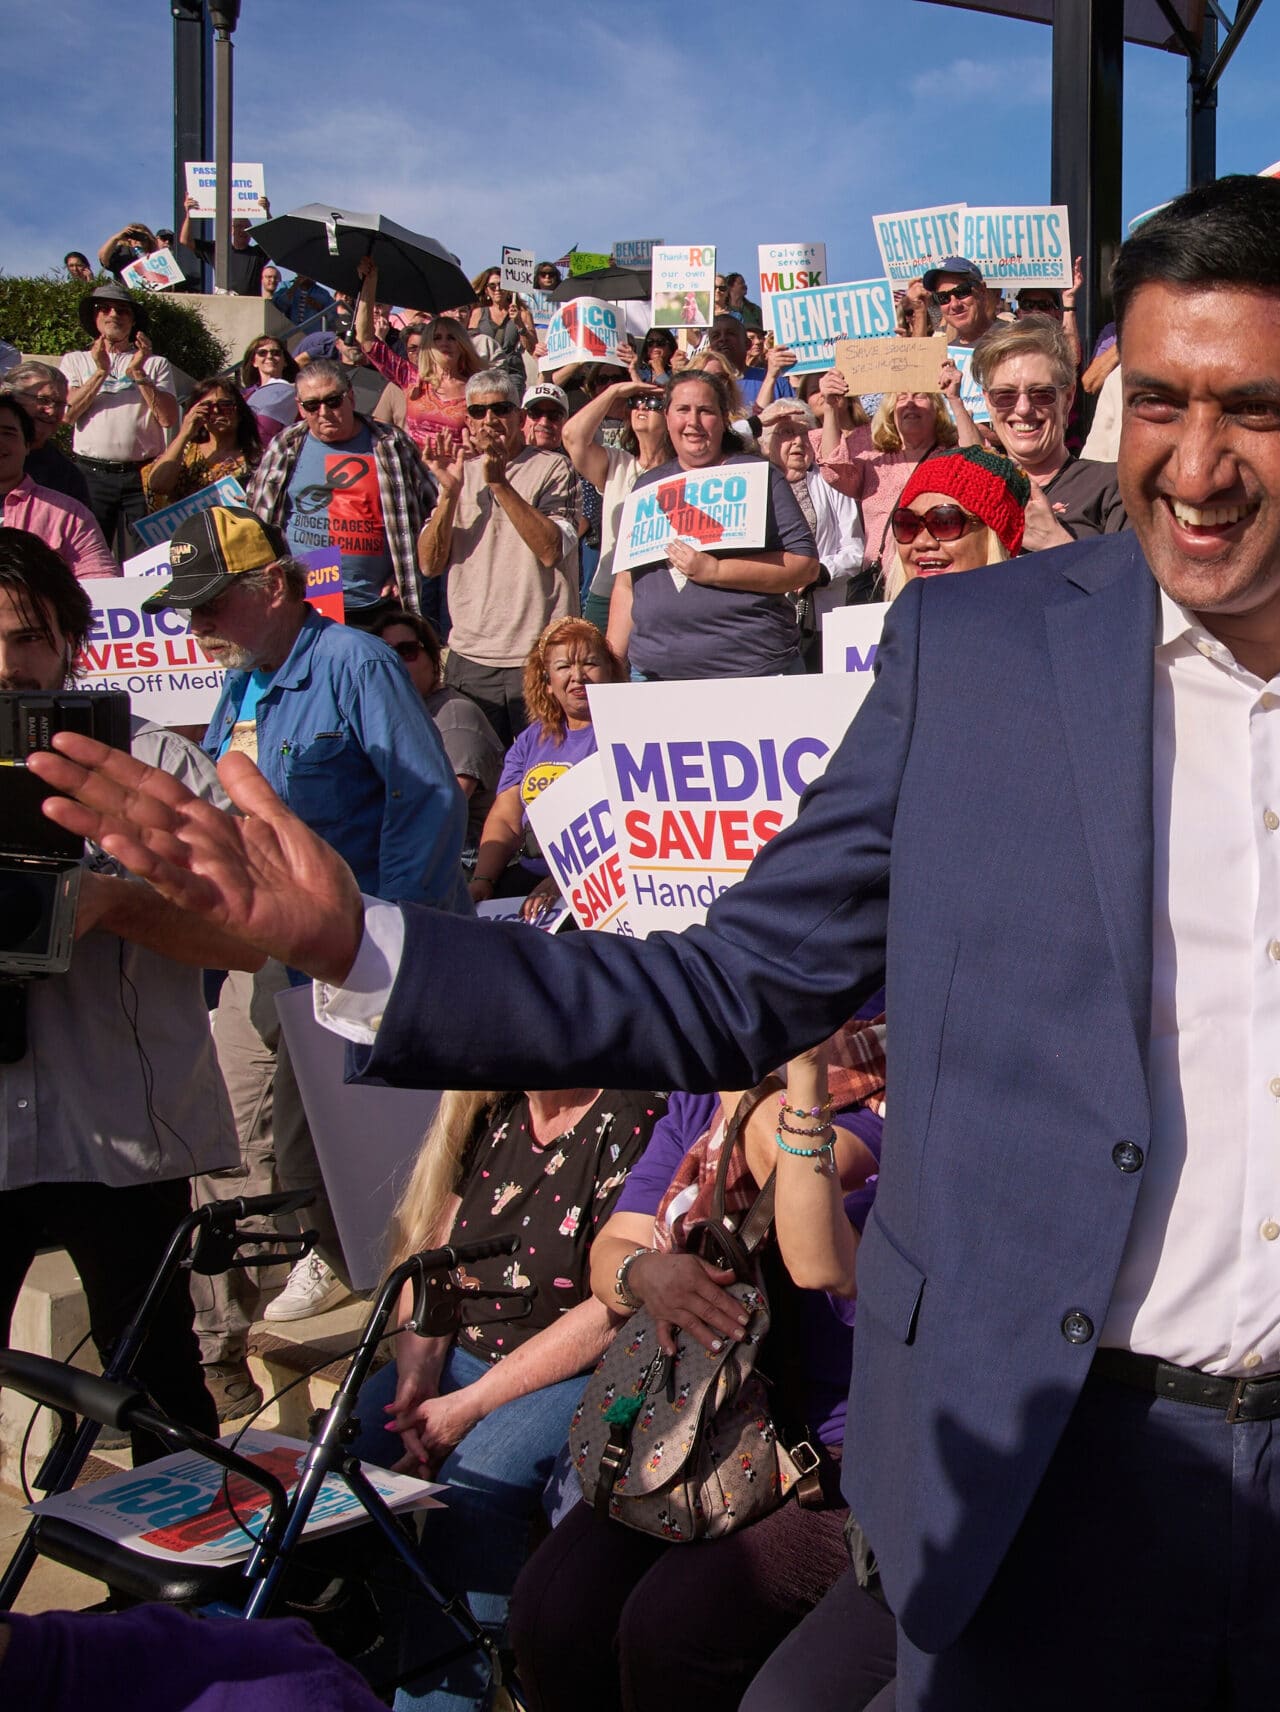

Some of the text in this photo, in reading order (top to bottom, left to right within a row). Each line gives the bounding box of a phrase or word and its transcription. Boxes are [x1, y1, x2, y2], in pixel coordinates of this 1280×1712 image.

[198, 179, 253, 189] DEMATIC
[238, 191, 259, 201] CLUB
[963, 213, 1063, 260] BENEFITS
[507, 256, 533, 268] DEPORT
[769, 248, 816, 258] Calvert
[777, 257, 811, 267] serves
[505, 268, 533, 285] MUSK
[889, 260, 938, 280] BILLIONA
[980, 262, 1064, 278] LLIONAIRES!
[666, 282, 685, 291] Rep
[760, 271, 822, 293] MUSK
[778, 286, 891, 346] BENEFITS
[535, 387, 561, 398] USA
[634, 475, 747, 524] NORCO
[294, 512, 330, 531] BIGGER
[630, 514, 674, 549] READY
[677, 508, 695, 536] TO
[697, 502, 747, 532] FIGHT!
[293, 531, 336, 548] LONGER
[307, 564, 341, 586] CUTS
[87, 607, 192, 641] EDIC
[75, 641, 159, 672] AVES
[127, 675, 163, 694] Off
[169, 670, 224, 691] Medi
[612, 736, 830, 803] MEDIC
[526, 772, 561, 793] sei
[571, 852, 627, 928] SAVE
